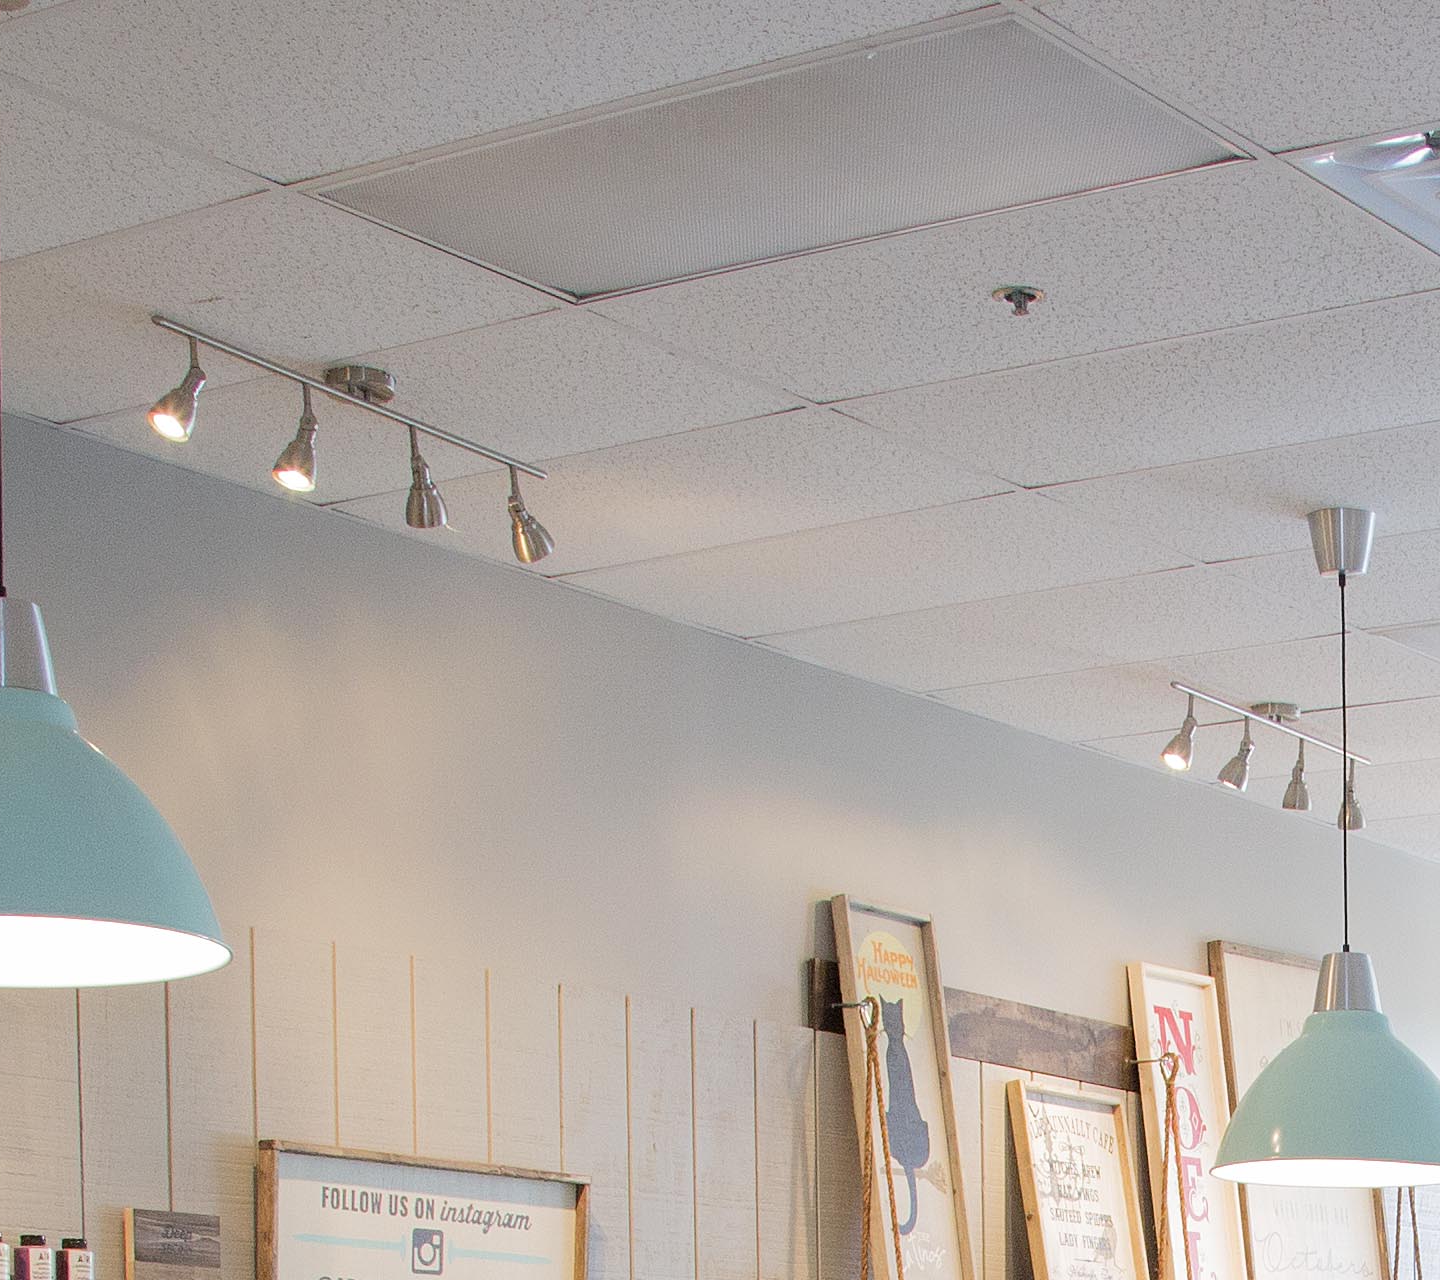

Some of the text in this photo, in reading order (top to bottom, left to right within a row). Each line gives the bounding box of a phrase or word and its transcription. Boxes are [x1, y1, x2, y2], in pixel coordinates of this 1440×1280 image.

[858, 957, 918, 991] HALLOWEEN
[321, 1185, 532, 1234] FOLLOW US ON instagram
[1058, 1231, 1079, 1249] LADY
